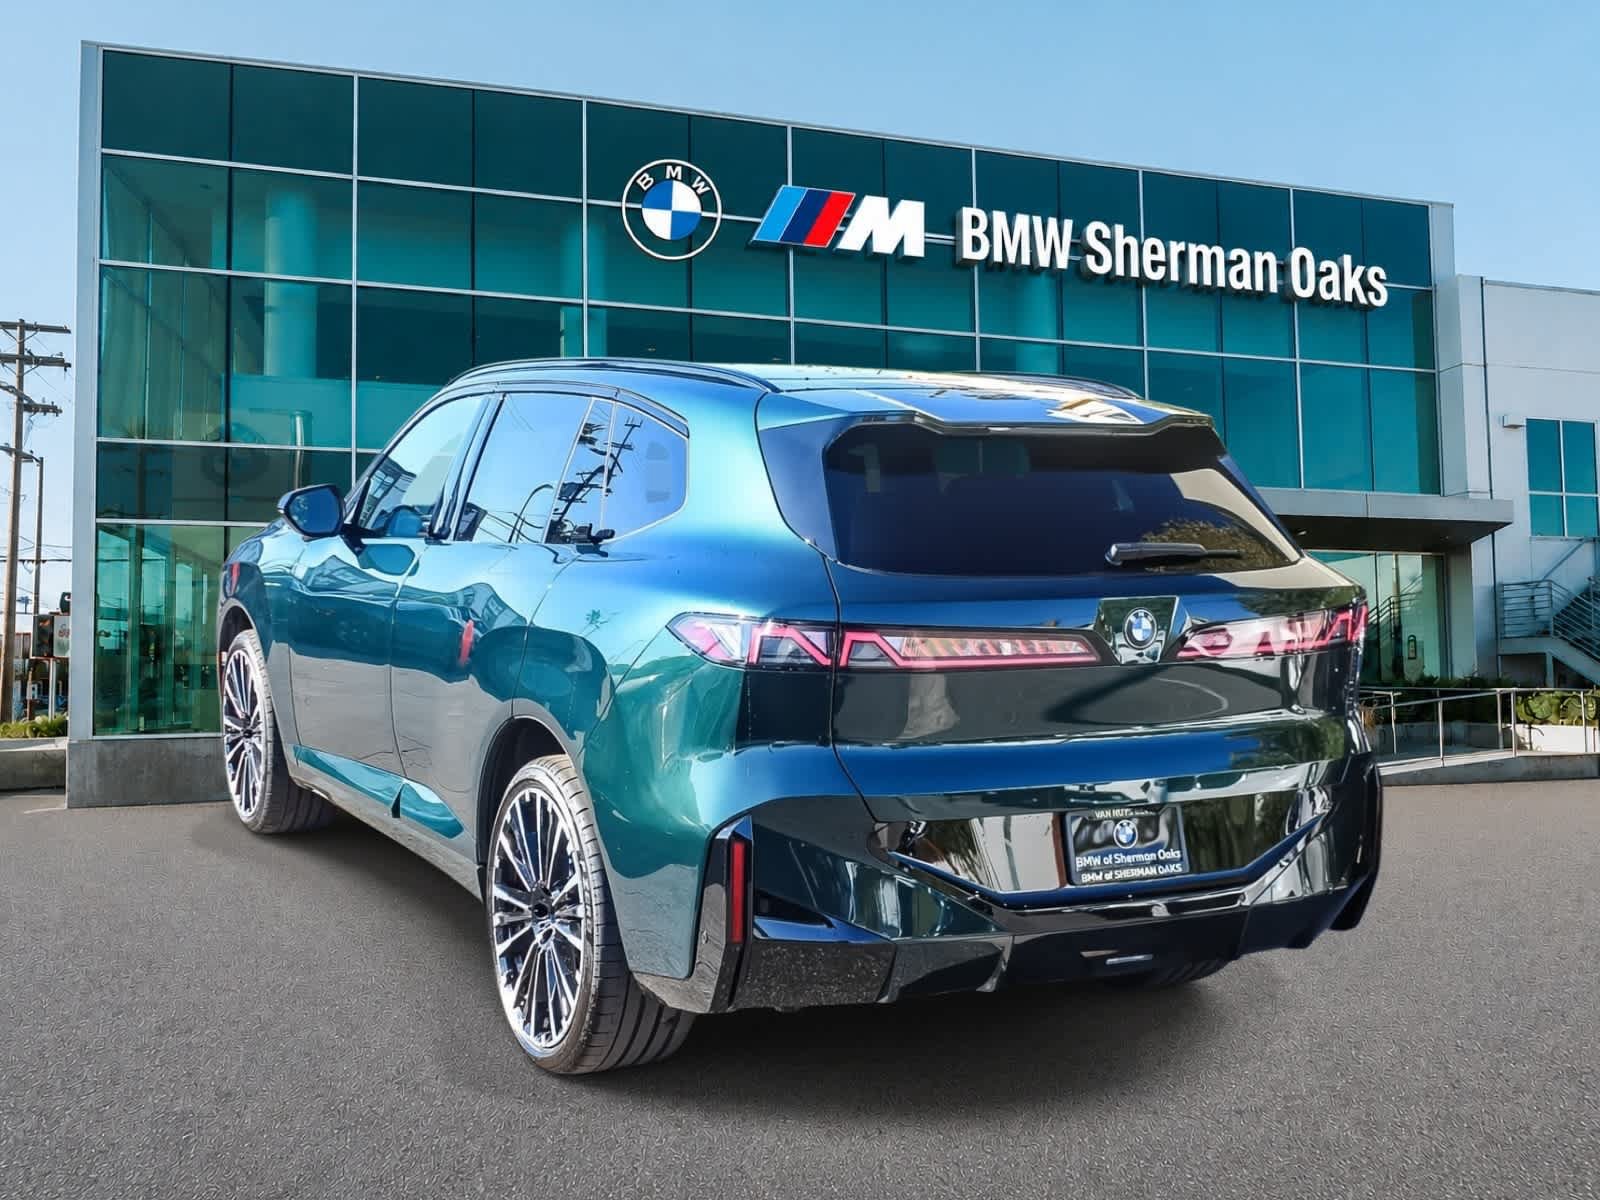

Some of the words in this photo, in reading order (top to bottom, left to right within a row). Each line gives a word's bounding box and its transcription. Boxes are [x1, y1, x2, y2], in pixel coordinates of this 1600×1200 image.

[636, 165, 711, 196] BMW
[960, 206, 1074, 271] BMW
[1085, 220, 1279, 294] Sherman
[1290, 246, 1389, 308] Oaks
[1076, 855, 1101, 868] BMW
[1103, 854, 1113, 864] of
[1114, 850, 1157, 864] Sherman
[1157, 848, 1181, 860] Oaks
[1081, 872, 1103, 883] BMW
[1115, 867, 1157, 879] SHERMAN
[1158, 863, 1182, 875] OAKS
